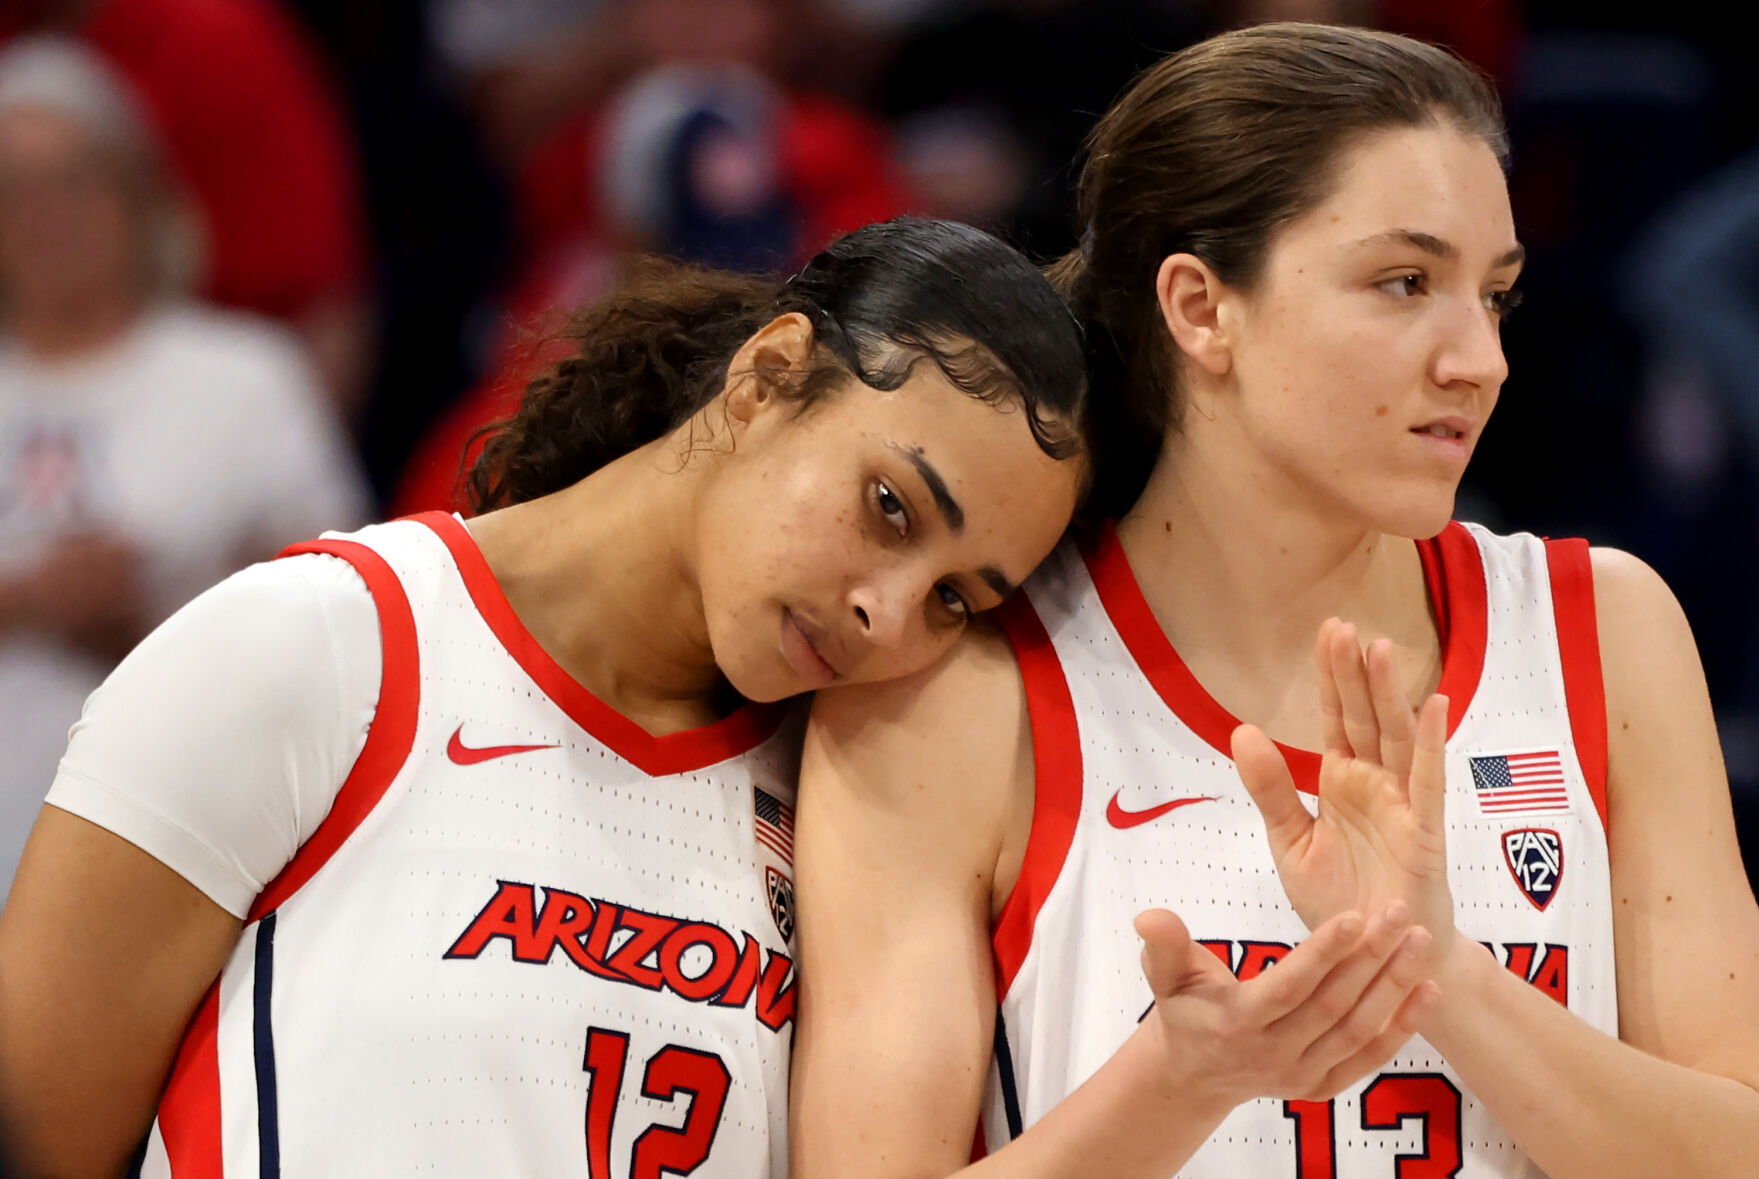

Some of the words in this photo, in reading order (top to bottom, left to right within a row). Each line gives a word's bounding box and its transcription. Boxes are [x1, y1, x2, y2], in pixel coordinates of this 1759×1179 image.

[1505, 831, 1560, 877] PAC
[1522, 861, 1552, 892] 12
[442, 879, 797, 1034] ARIZON
[582, 1026, 732, 1179] 12
